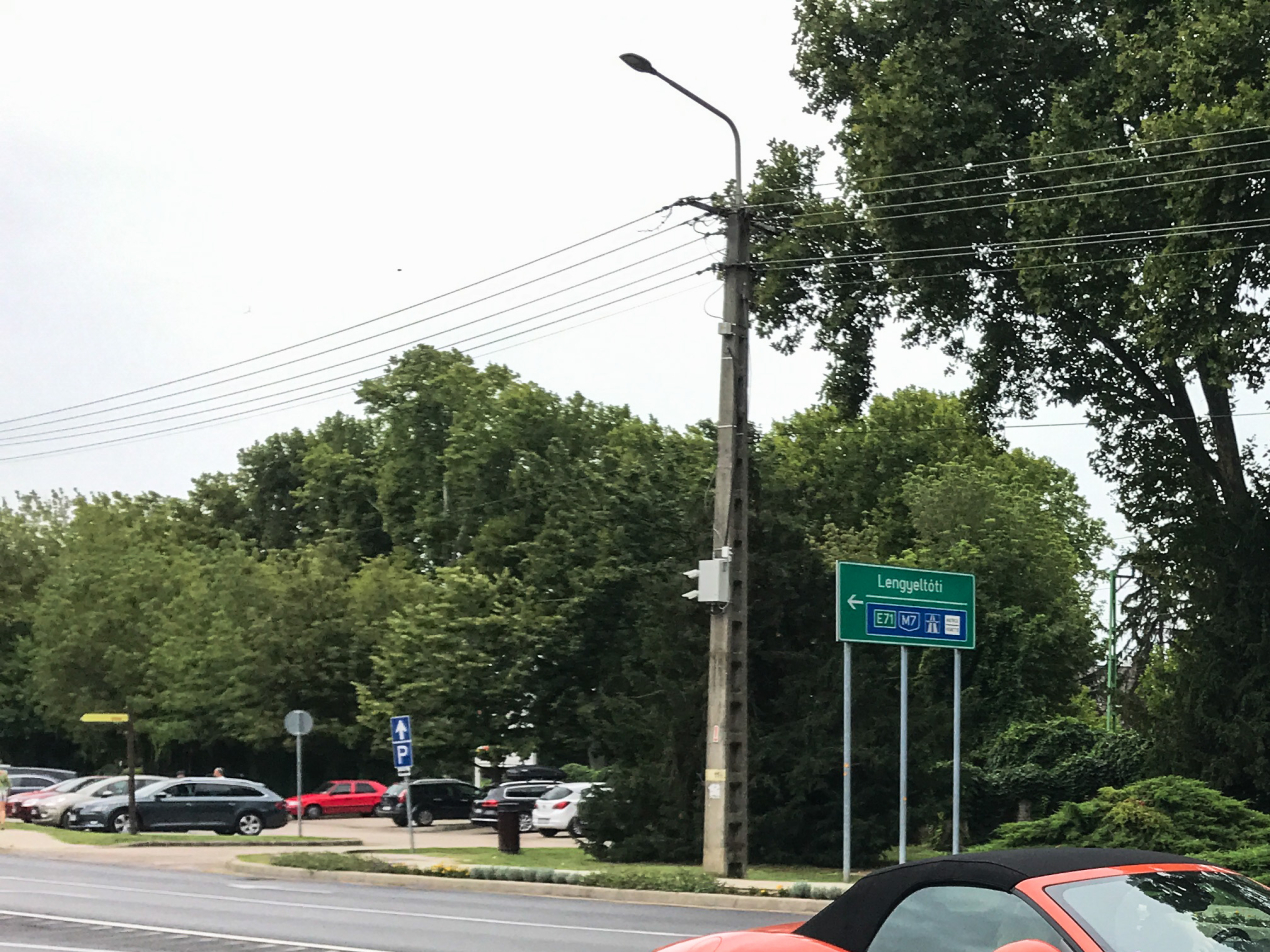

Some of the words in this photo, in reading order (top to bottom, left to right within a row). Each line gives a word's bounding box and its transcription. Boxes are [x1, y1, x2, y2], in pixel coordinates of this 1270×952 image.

[877, 573, 943, 594] Lengyeltóti
[876, 612, 894, 625] E71
[901, 614, 917, 626] M7
[396, 745, 408, 765] P
